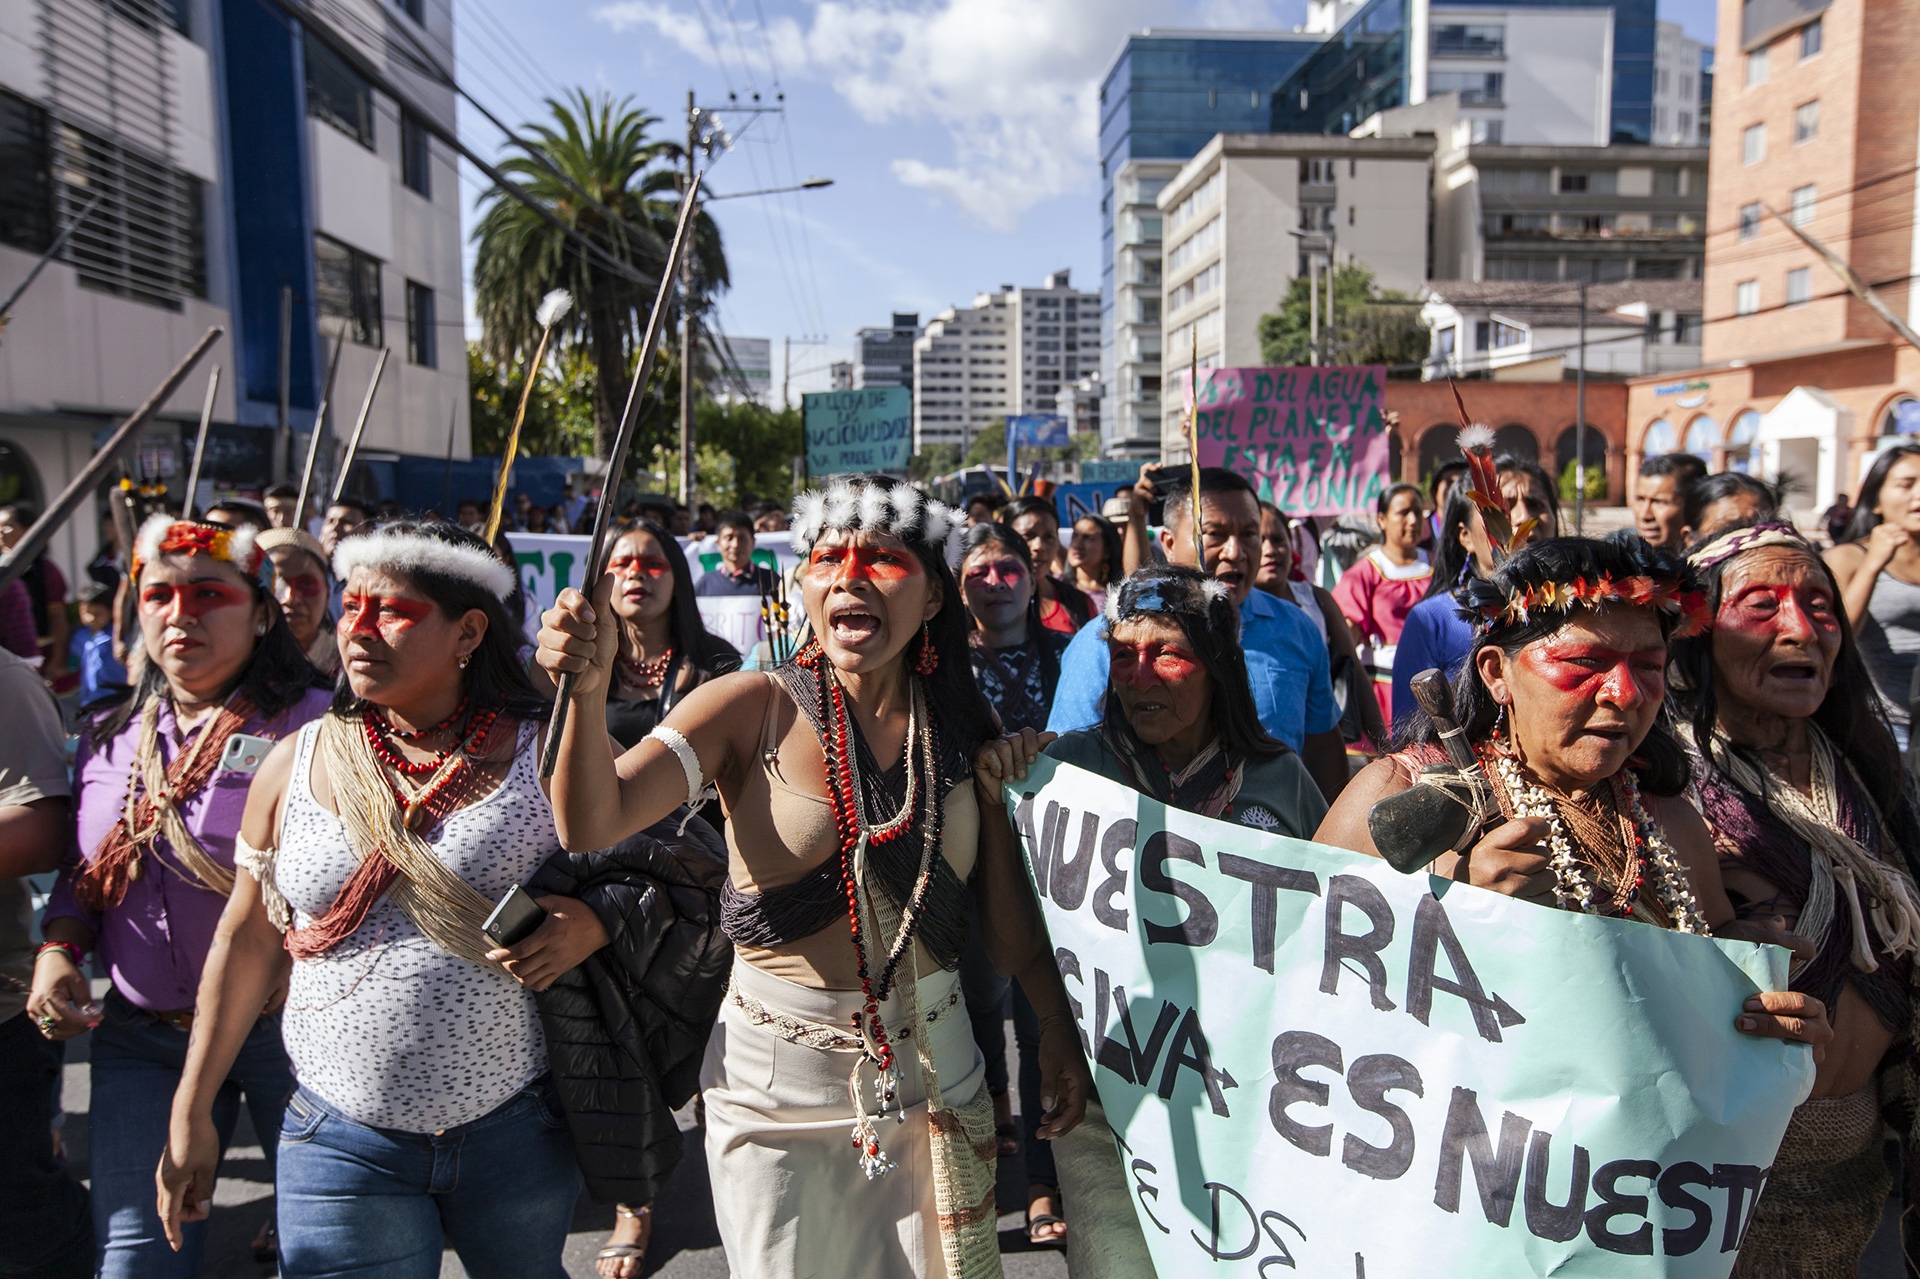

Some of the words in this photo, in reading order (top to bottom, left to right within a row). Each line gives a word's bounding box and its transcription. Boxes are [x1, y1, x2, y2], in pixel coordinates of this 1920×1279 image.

[867, 391, 887, 409] DE
[1252, 372, 1298, 402] DEL
[1305, 370, 1380, 402] AGUA
[1197, 409, 1238, 441] DEL
[1248, 403, 1384, 440] PLANETA
[1223, 442, 1296, 474] ESTA
[1309, 442, 1352, 472] EN
[1247, 471, 1383, 511] AZONIA
[1013, 792, 1526, 1043] NUESTRA
[1269, 1030, 1424, 1180] ES
[1191, 1182, 1307, 1279] DE
